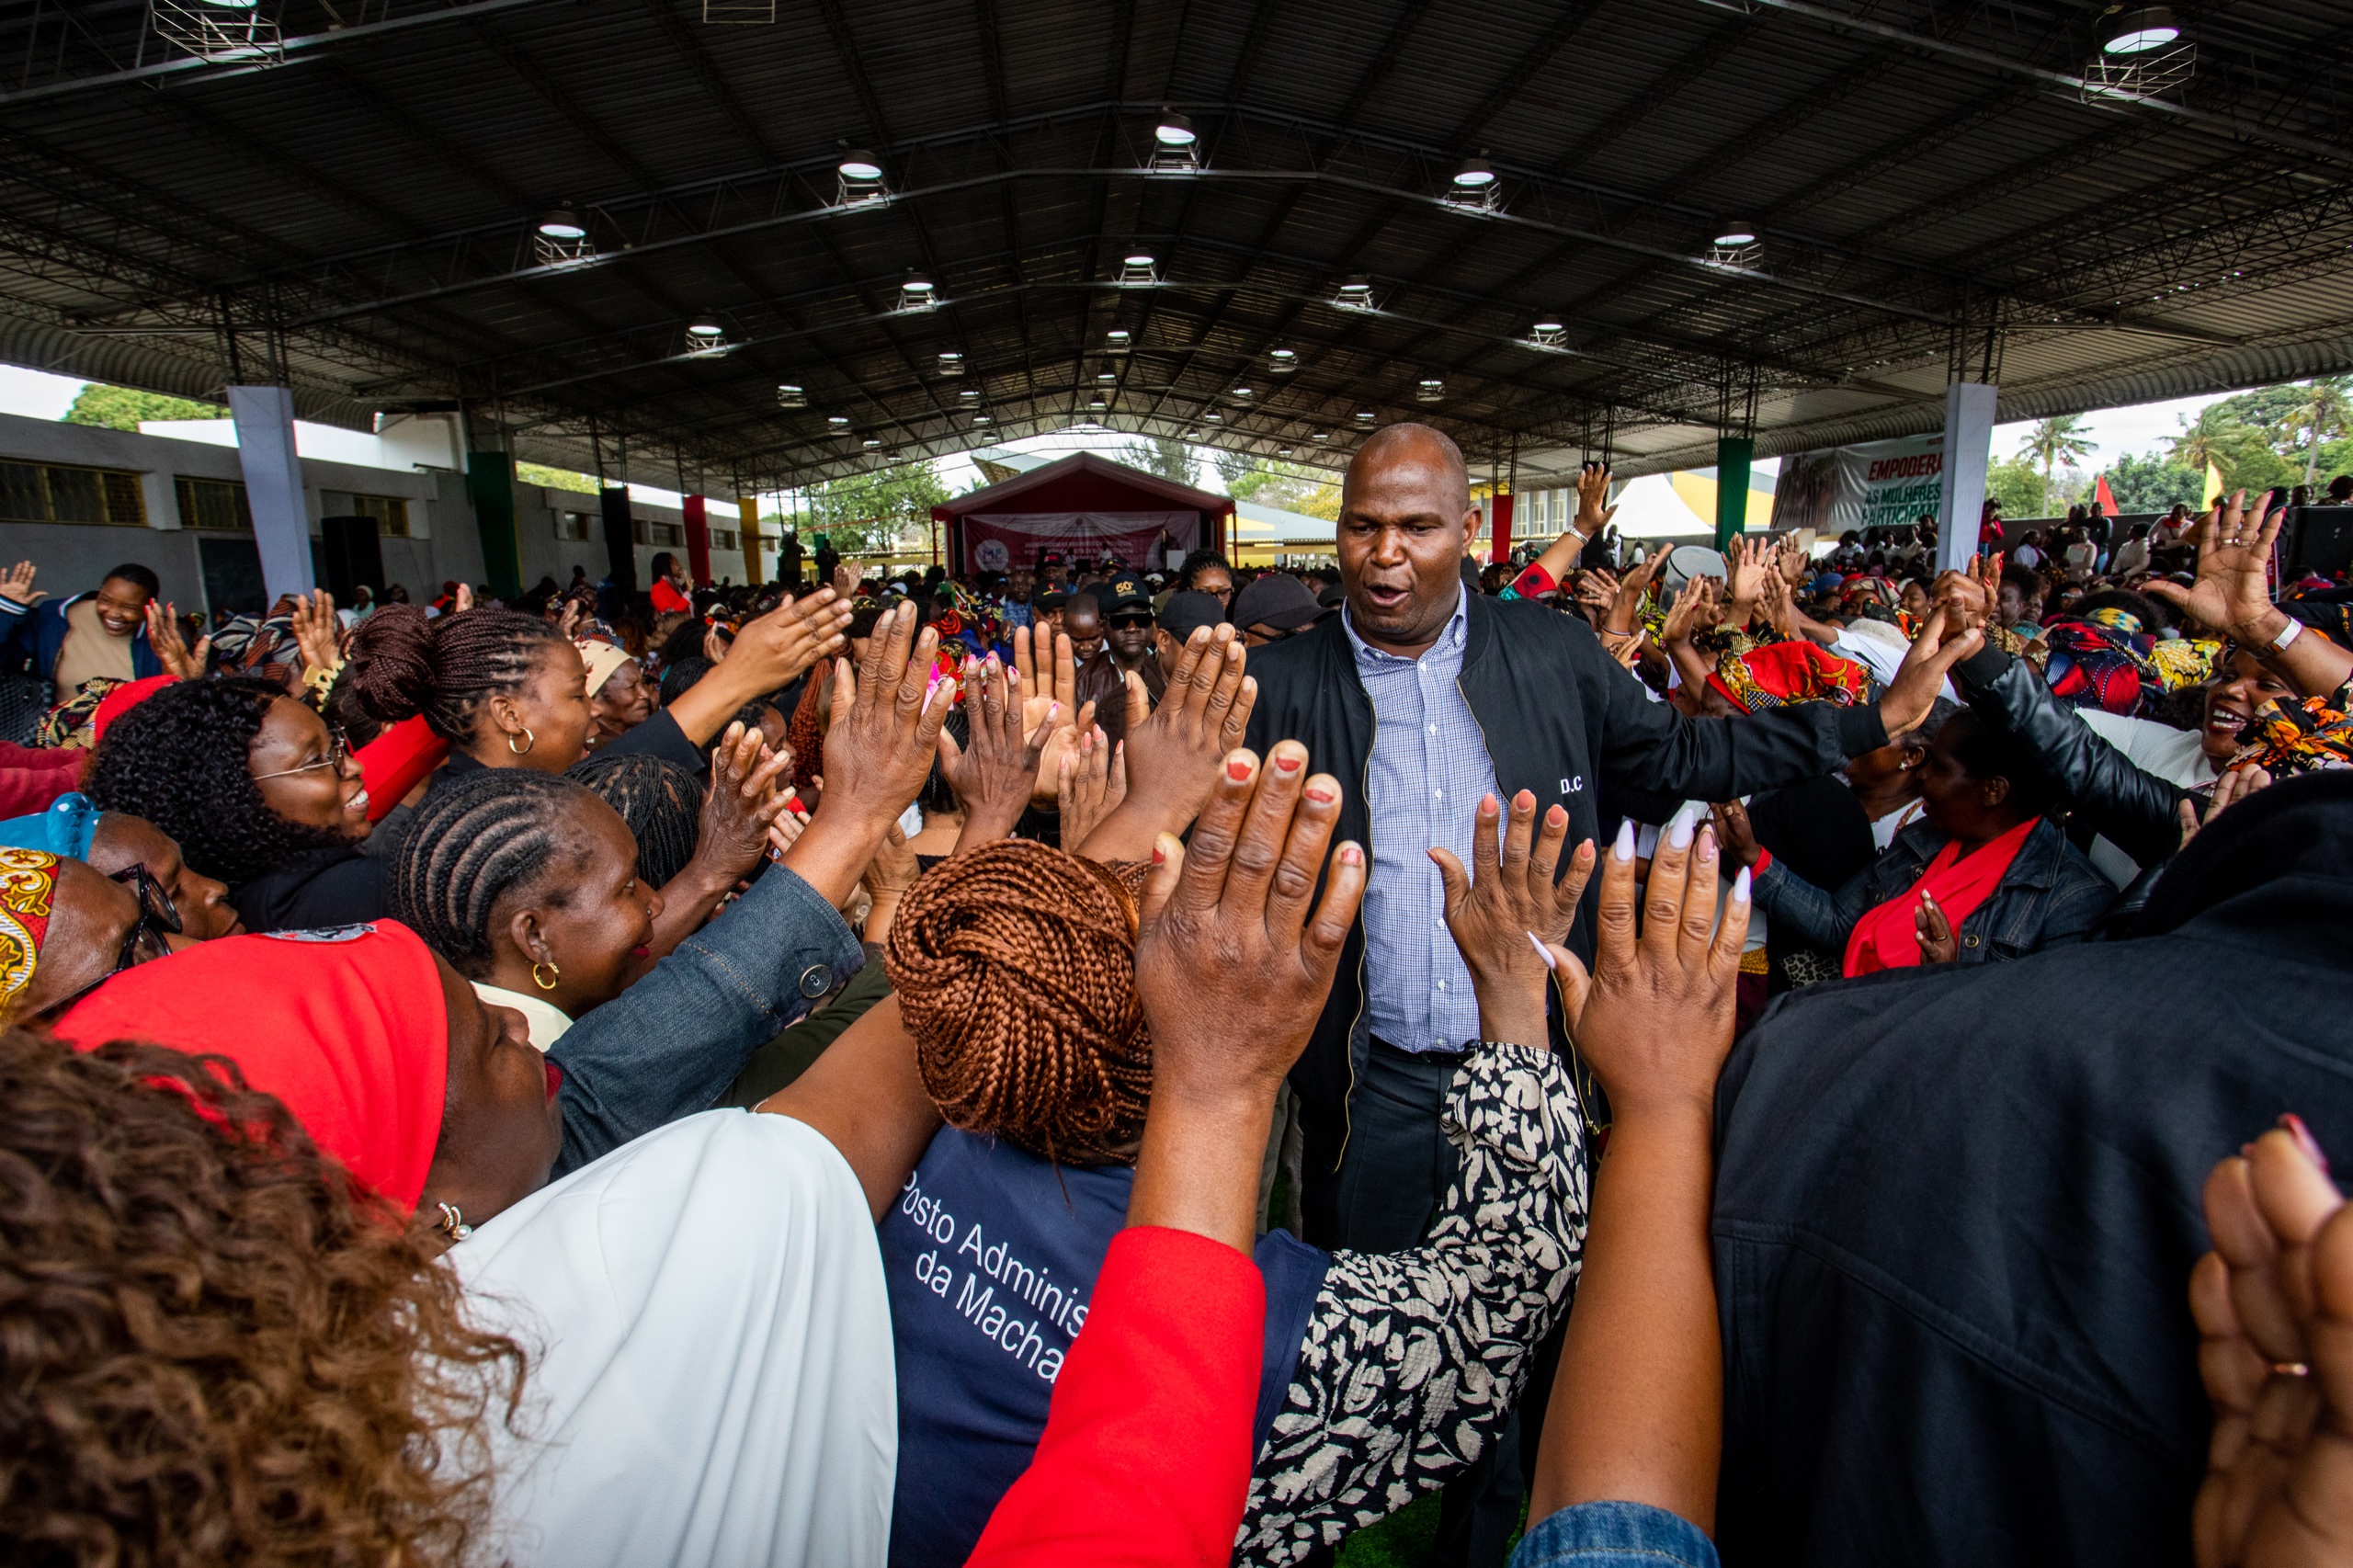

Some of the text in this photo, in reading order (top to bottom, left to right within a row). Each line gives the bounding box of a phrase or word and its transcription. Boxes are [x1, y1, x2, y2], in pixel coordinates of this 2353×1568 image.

[1866, 483, 1941, 505] AS MULHERES
[1560, 776, 1583, 794] D.C
[903, 1170, 955, 1244] Posto
[915, 1250, 953, 1298] da
